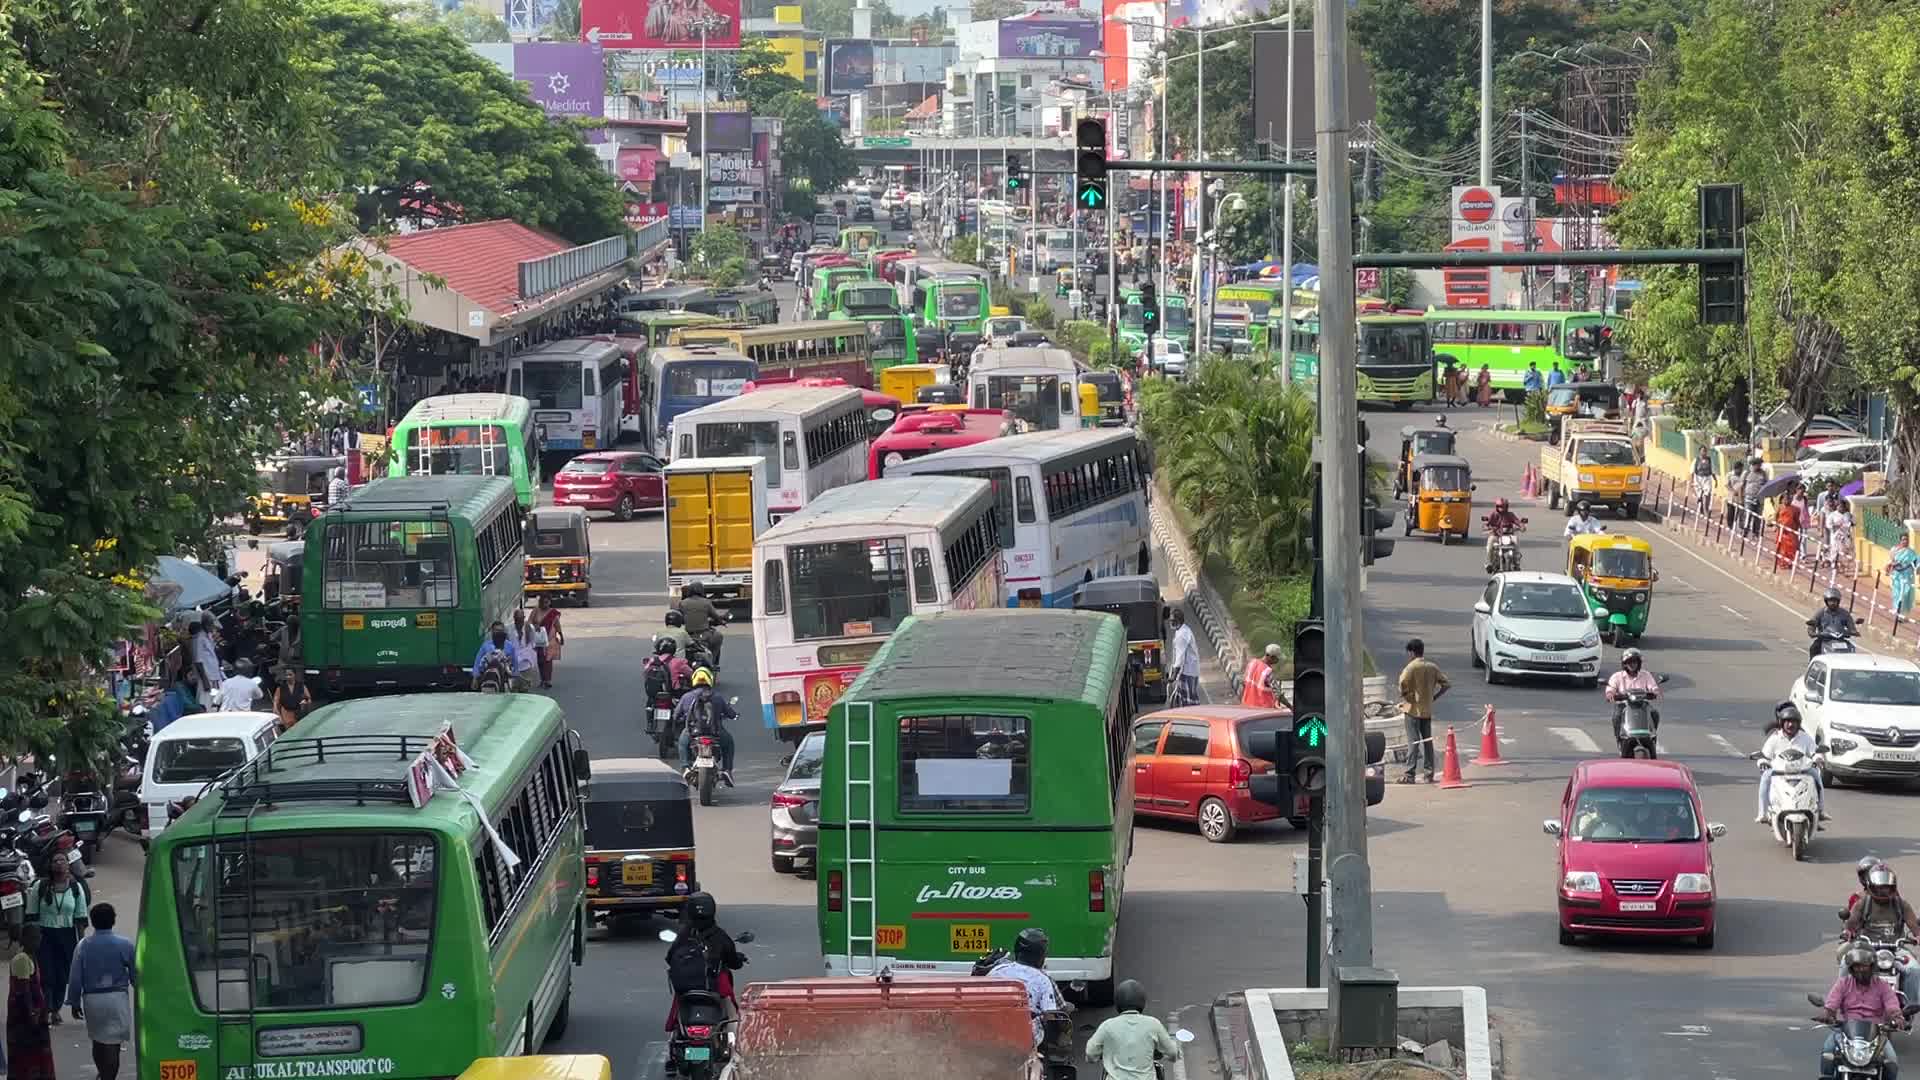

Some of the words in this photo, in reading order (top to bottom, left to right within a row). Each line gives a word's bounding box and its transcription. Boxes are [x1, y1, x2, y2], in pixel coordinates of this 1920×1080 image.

[1458, 223, 1496, 232] IndianOil
[1359, 270, 1376, 283] 24
[948, 866, 967, 874] CITY
[969, 866, 986, 874] BUS
[876, 928, 904, 945] STOP
[161, 1064, 195, 1080] STOP
[296, 1058, 376, 1078] TRANSPORT
